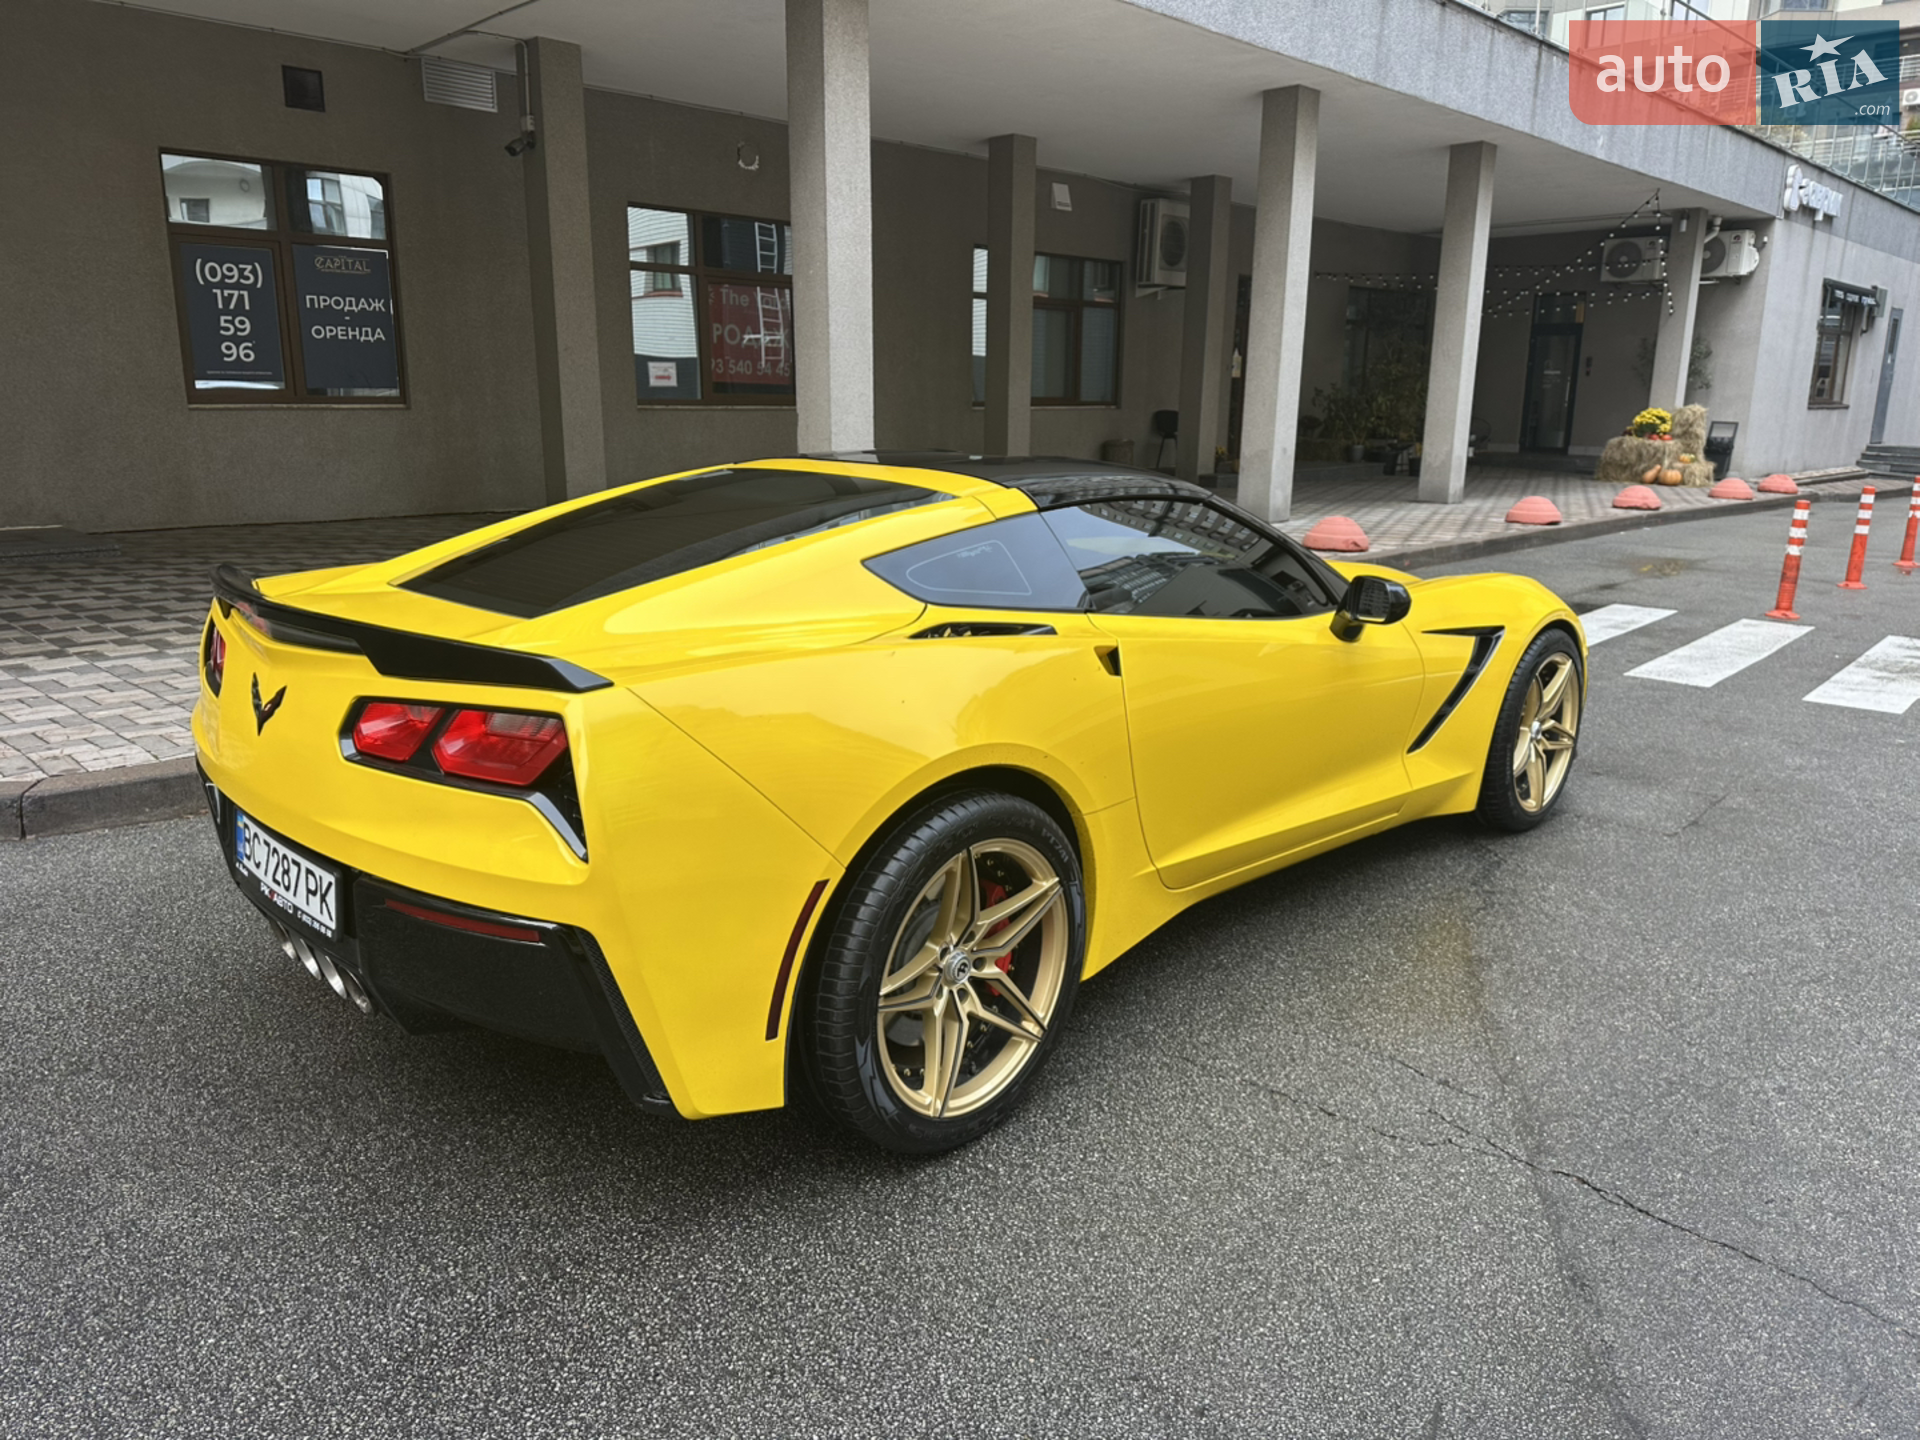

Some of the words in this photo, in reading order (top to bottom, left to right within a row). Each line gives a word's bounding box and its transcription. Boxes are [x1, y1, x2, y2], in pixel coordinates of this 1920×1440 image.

[195, 258, 263, 288] (093)
[314, 256, 371, 273] CAPITAL
[212, 289, 250, 310] 171
[305, 294, 386, 313] ПРОДАЖ
[720, 288, 749, 307] The
[219, 315, 251, 336] 59
[311, 325, 386, 343] ОРЕНДА
[221, 341, 255, 362] 96
[728, 359, 753, 375] 540
[775, 362, 791, 377] 45
